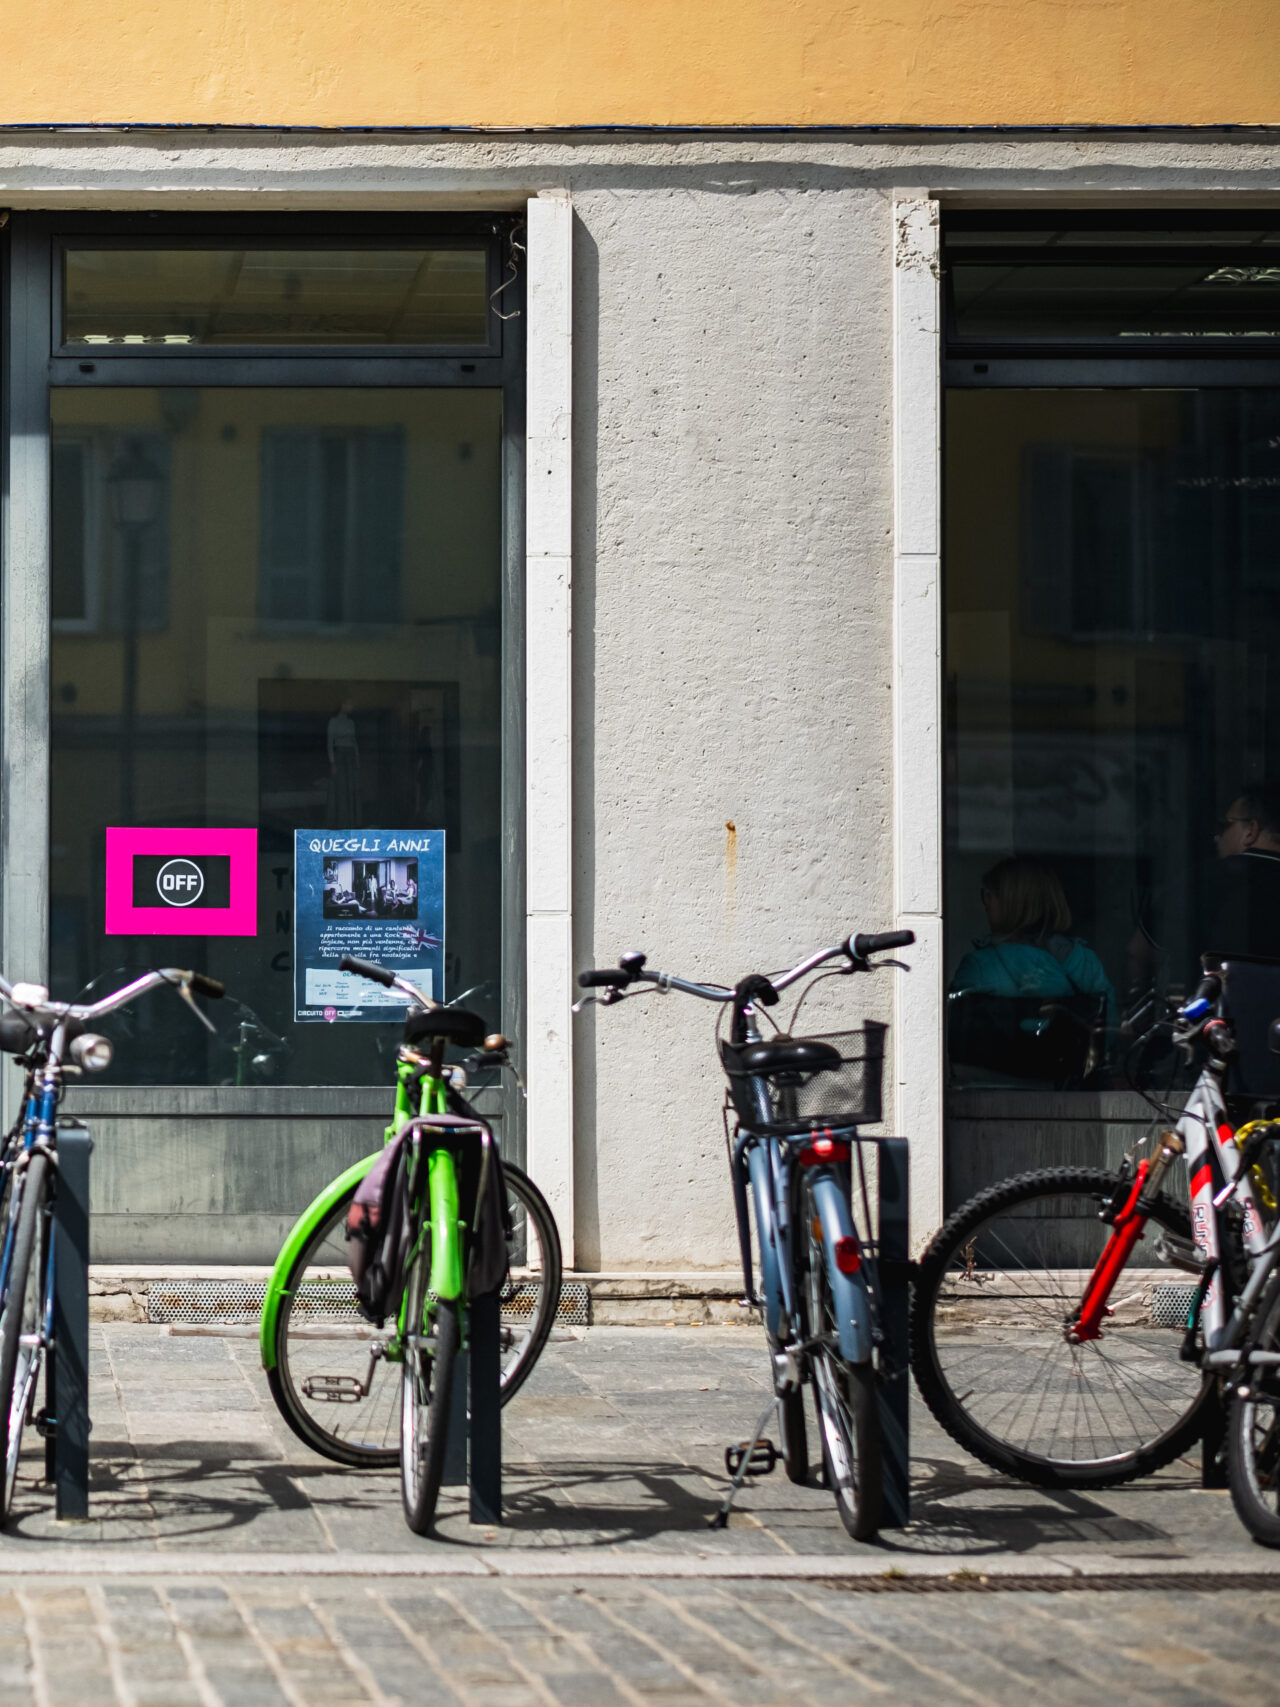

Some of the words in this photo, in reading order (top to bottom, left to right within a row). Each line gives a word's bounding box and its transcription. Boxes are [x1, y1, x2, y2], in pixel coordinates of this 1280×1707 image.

[309, 838, 381, 853] QUEGLI
[386, 838, 431, 852] ANNI
[162, 874, 198, 890] OFF
